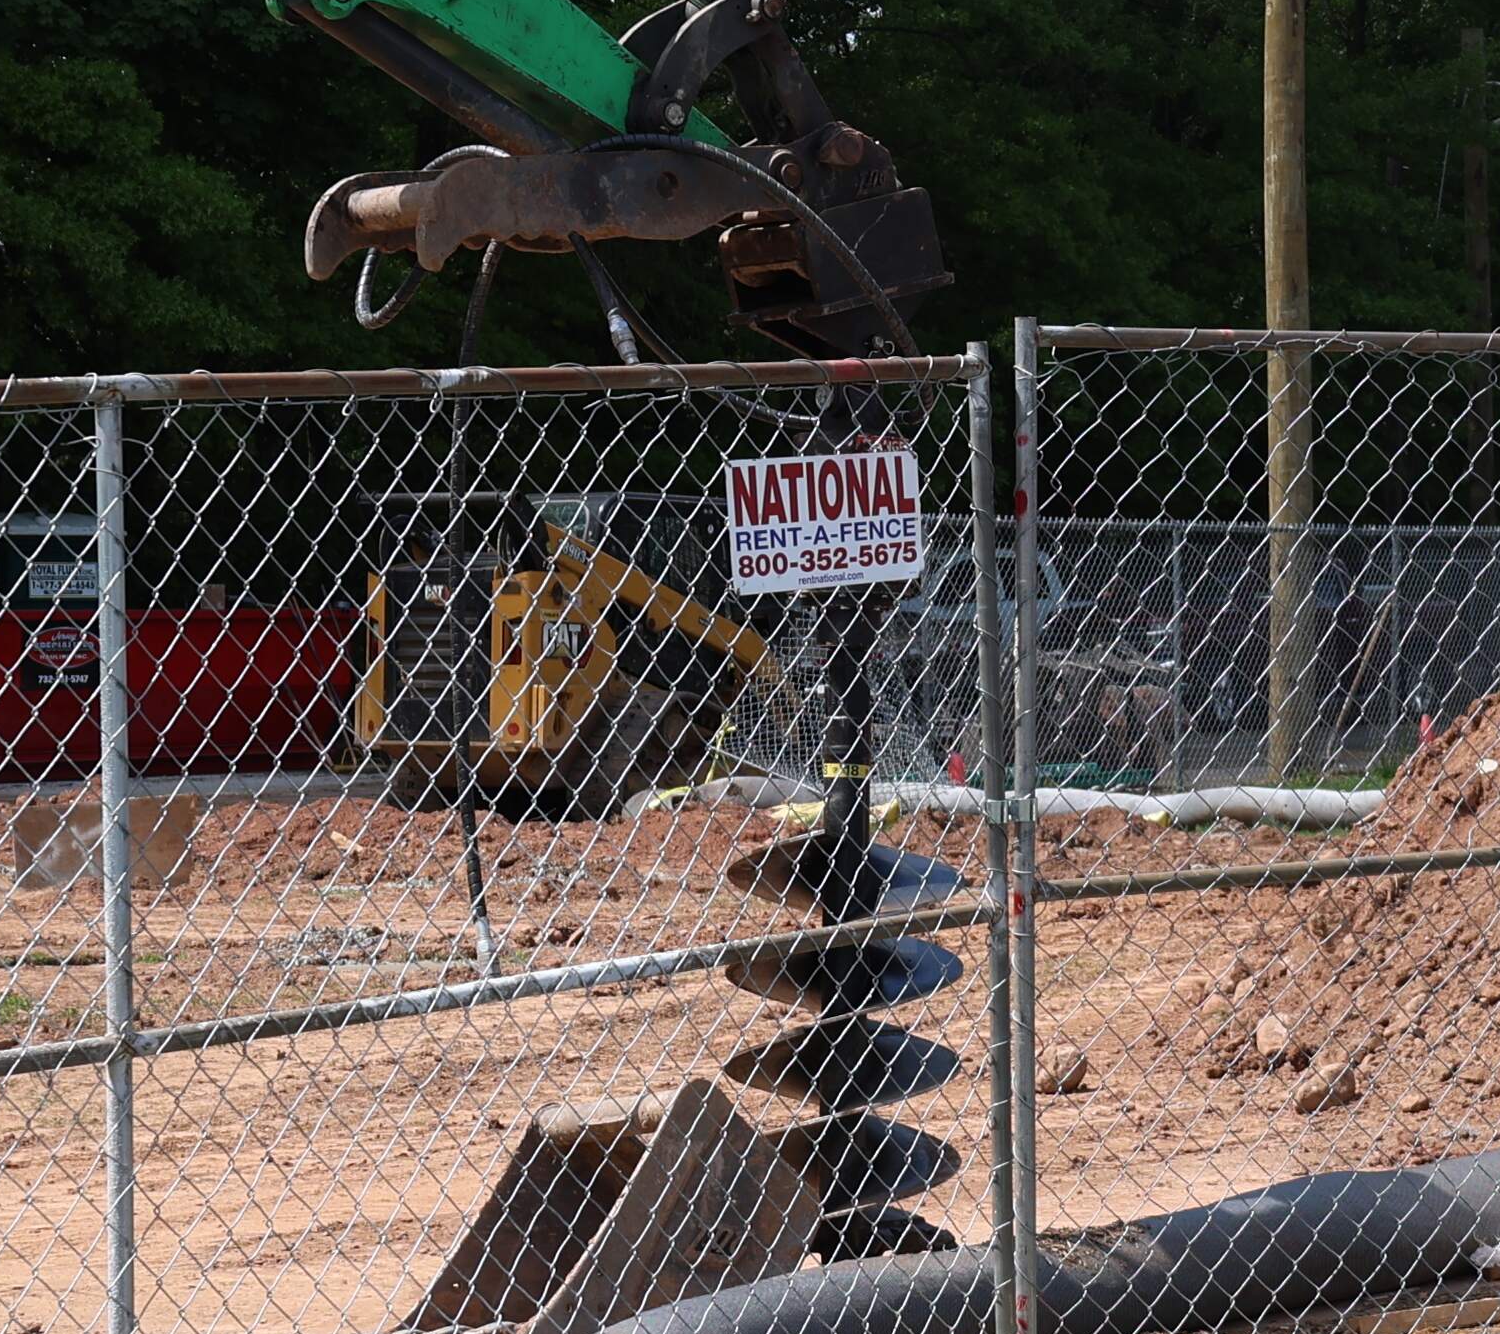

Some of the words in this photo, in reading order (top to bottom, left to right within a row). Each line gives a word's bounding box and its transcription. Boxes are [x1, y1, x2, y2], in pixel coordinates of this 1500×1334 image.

[732, 456, 916, 527] NATIONAL
[736, 517, 917, 552] RENT-A-FENCE
[738, 540, 918, 579] 800-352-5675
[424, 584, 444, 602] CAT
[798, 571, 864, 586] rentnational.com
[543, 622, 581, 658] CAT
